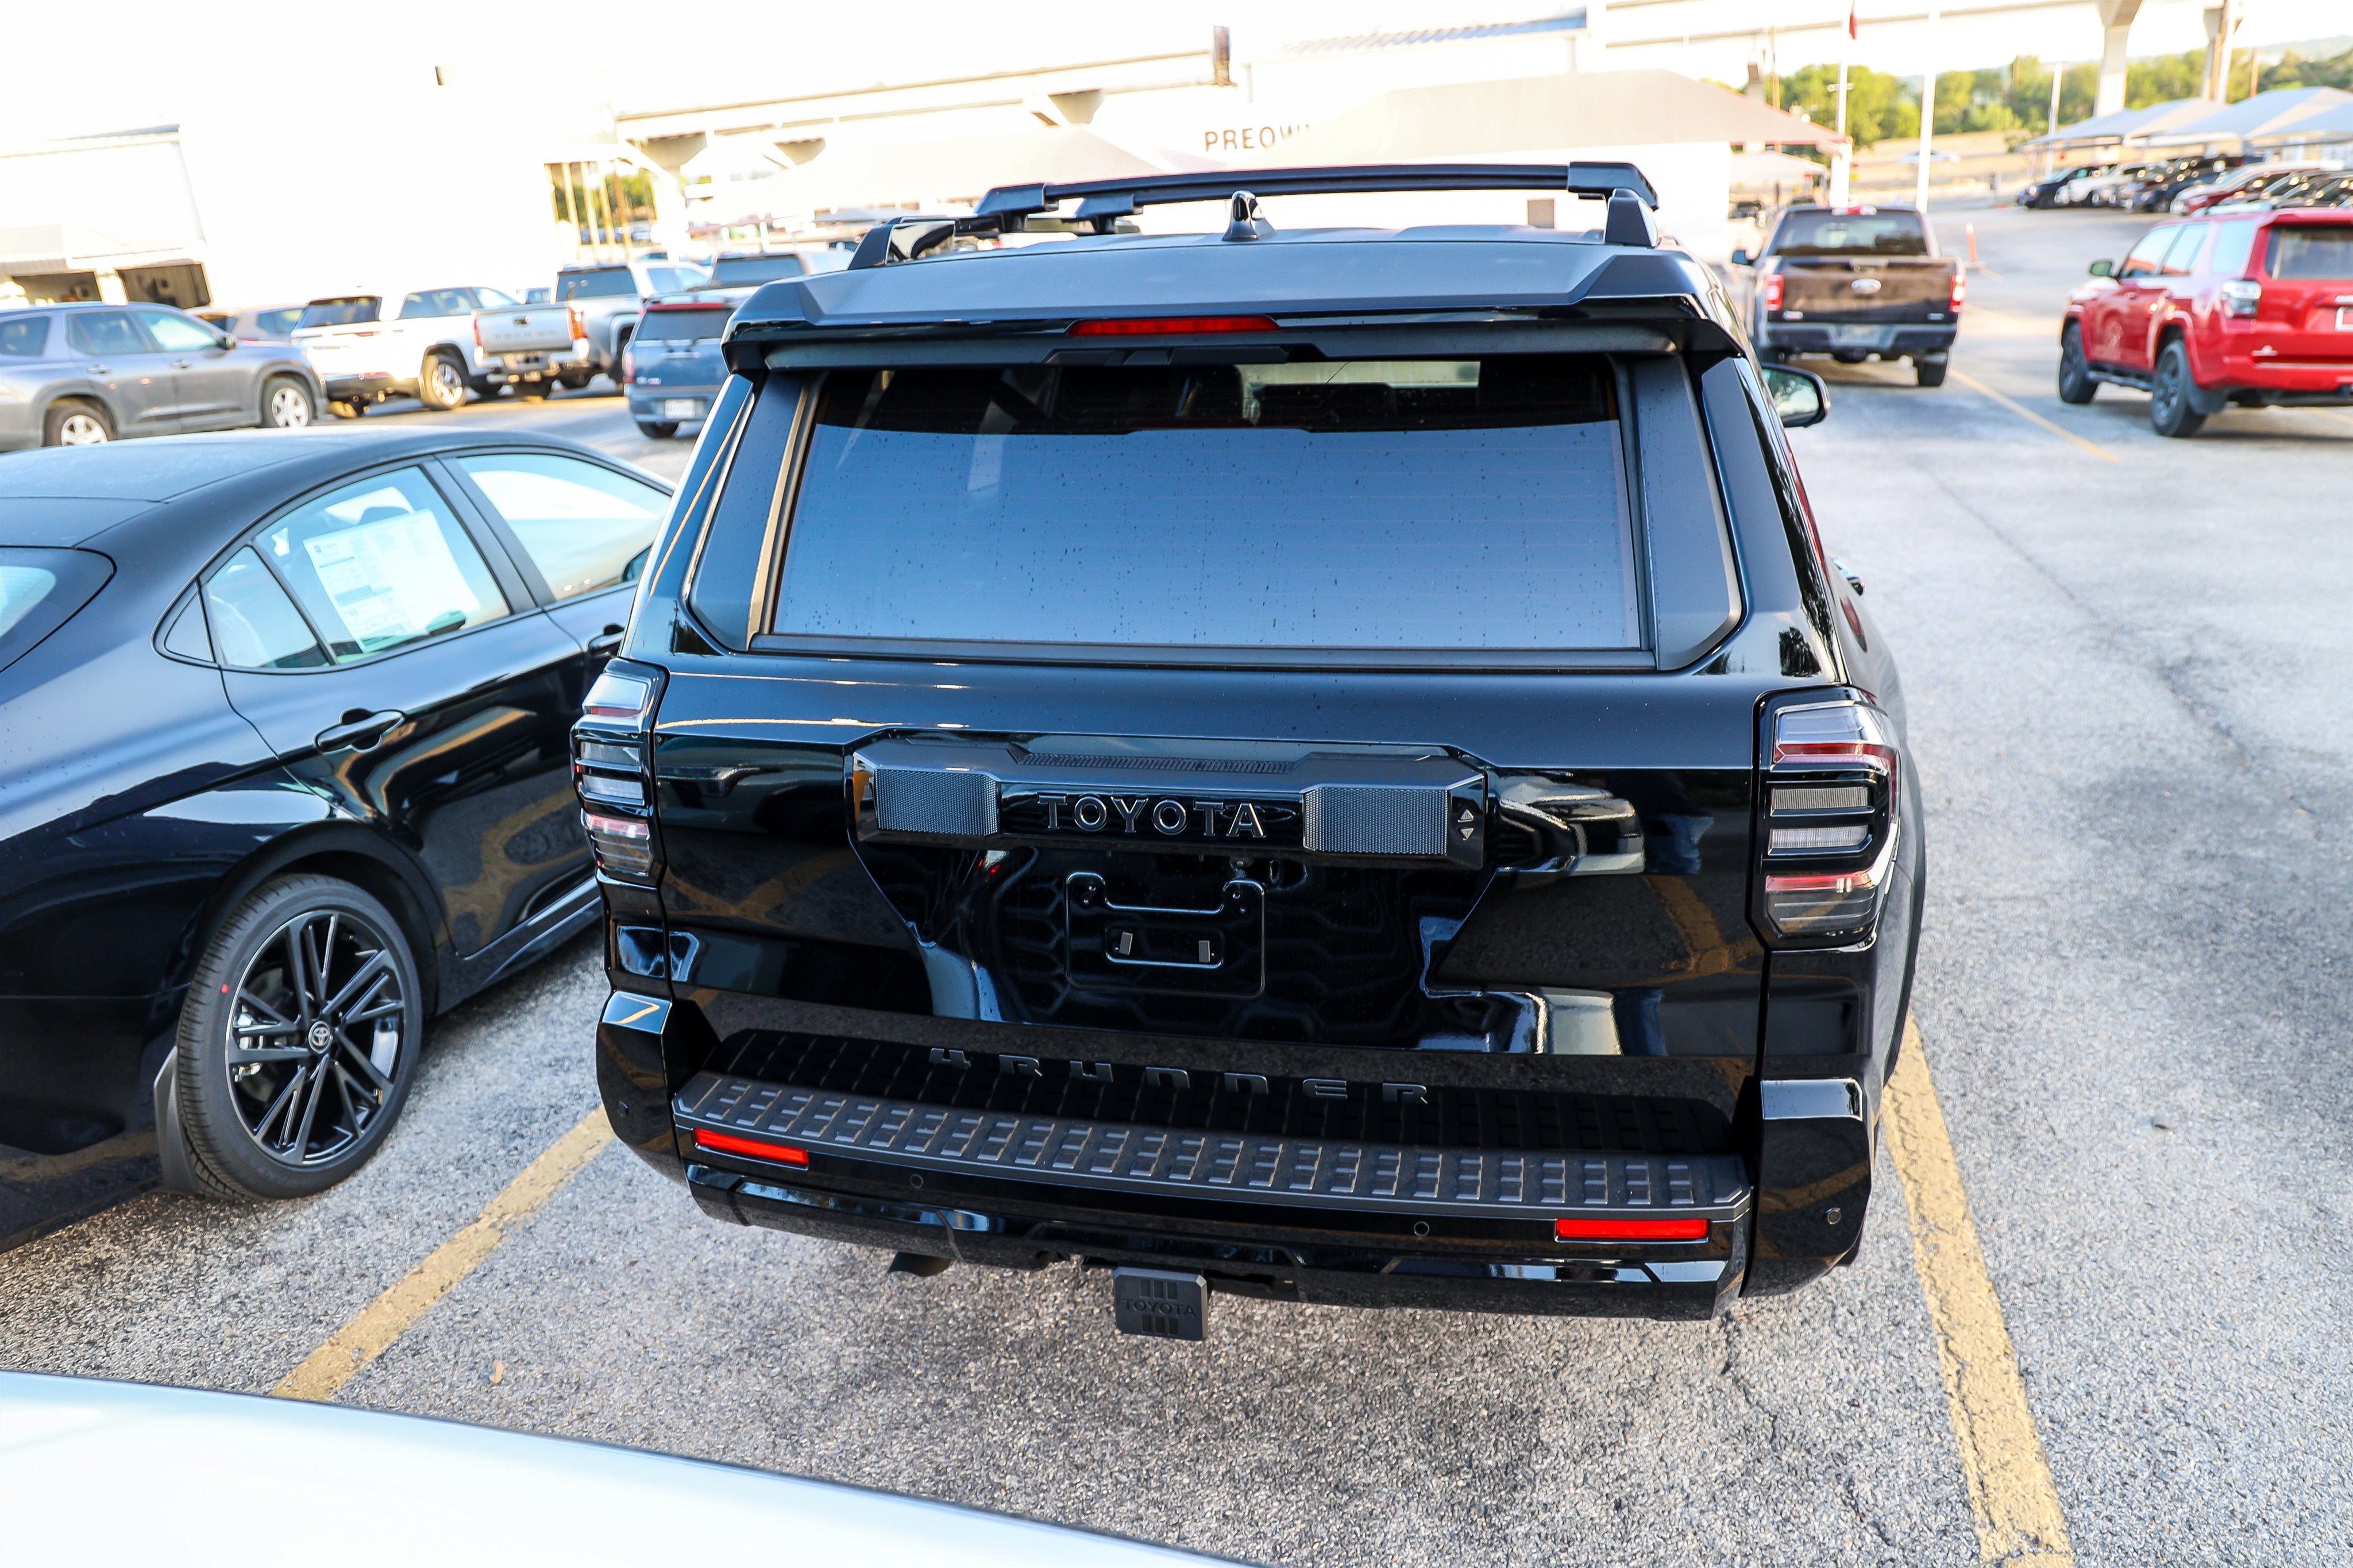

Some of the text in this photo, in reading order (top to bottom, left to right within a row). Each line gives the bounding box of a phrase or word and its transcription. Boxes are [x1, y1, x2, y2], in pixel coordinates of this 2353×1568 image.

[1037, 794, 1266, 838] TOYOTA
[928, 1047, 1428, 1104] 4RUNNER
[1121, 1298, 1196, 1317] TOYOTA
